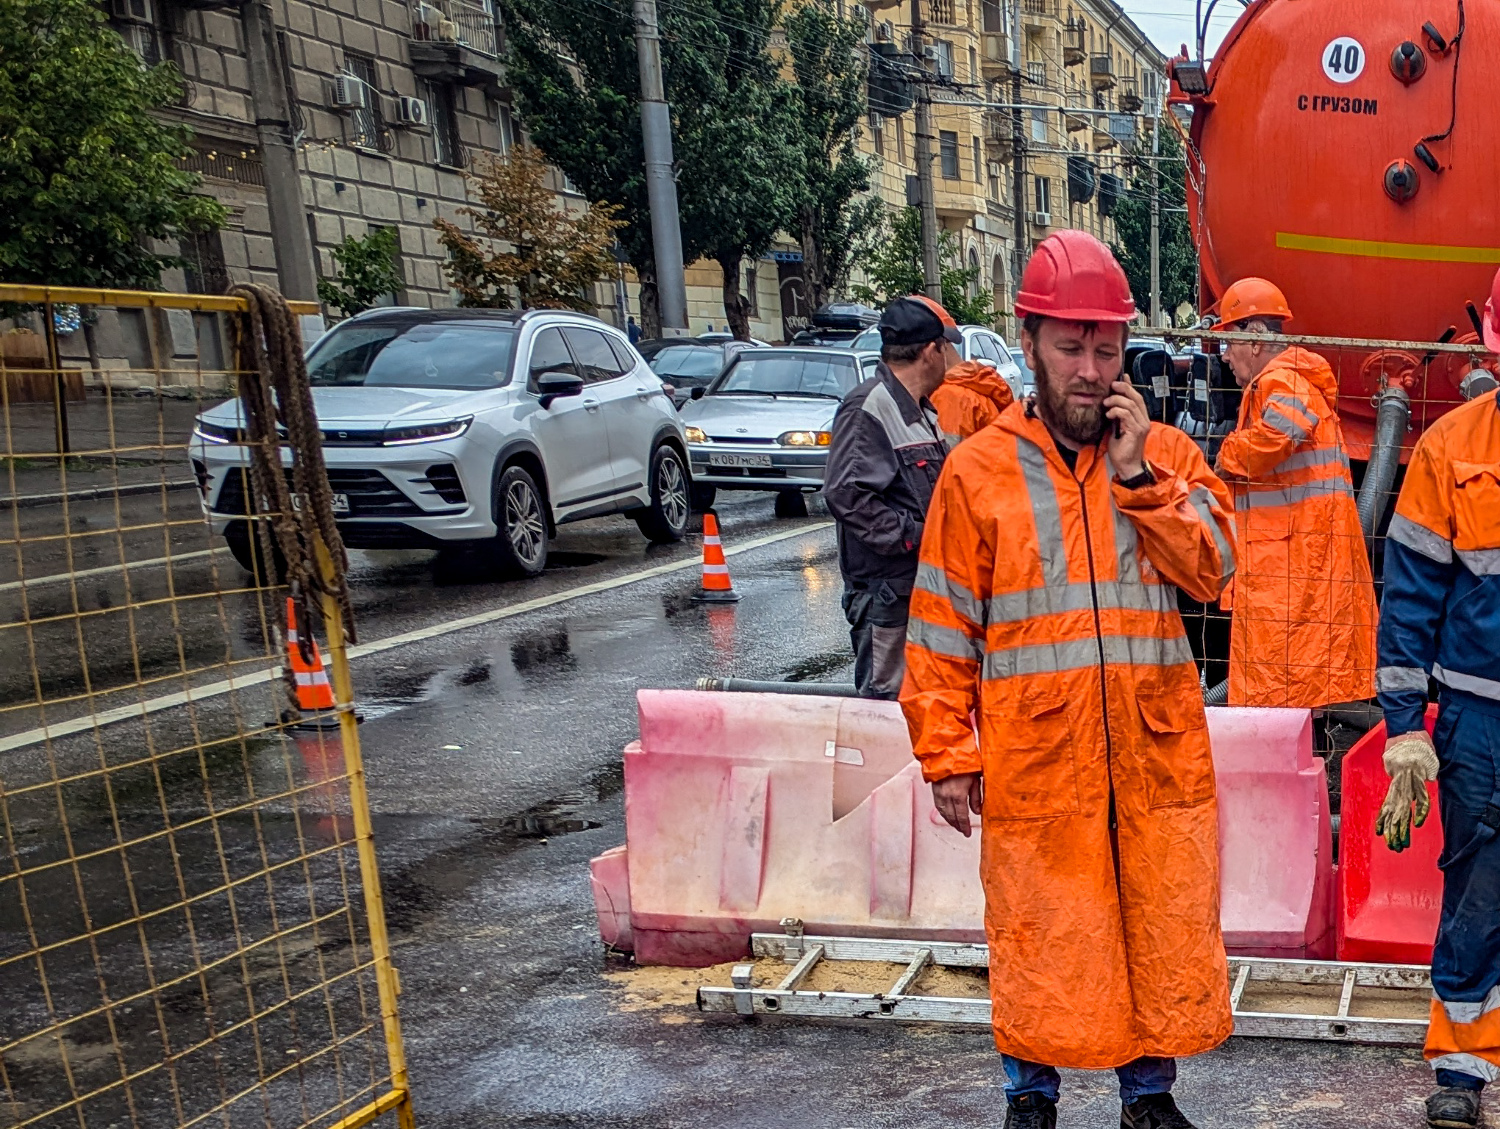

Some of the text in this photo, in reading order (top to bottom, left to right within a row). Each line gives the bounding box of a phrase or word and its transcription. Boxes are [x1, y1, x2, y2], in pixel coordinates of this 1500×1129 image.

[1328, 44, 1359, 74] 40
[1297, 94, 1378, 115] С ГРУЗОМ
